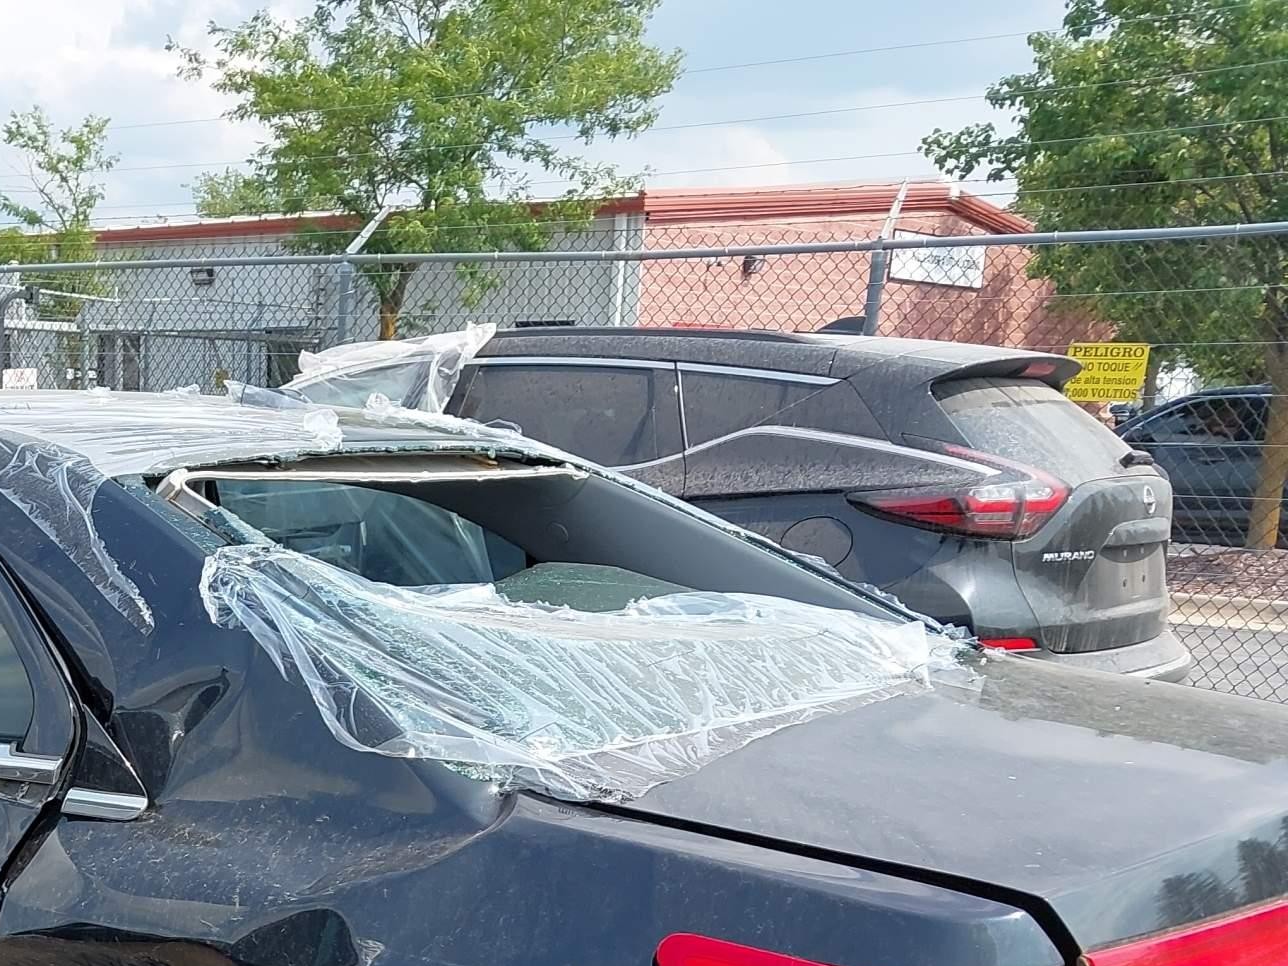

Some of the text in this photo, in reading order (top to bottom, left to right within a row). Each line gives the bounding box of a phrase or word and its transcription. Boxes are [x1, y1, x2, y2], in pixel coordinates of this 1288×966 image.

[1072, 346, 1145, 358] PELIGRO
[1097, 361, 1131, 372] TOQUE
[1083, 375, 1101, 385] alta
[1103, 375, 1137, 386] tension
[1091, 387, 1137, 399] VOLTIOS
[1042, 550, 1095, 562] MURANO
